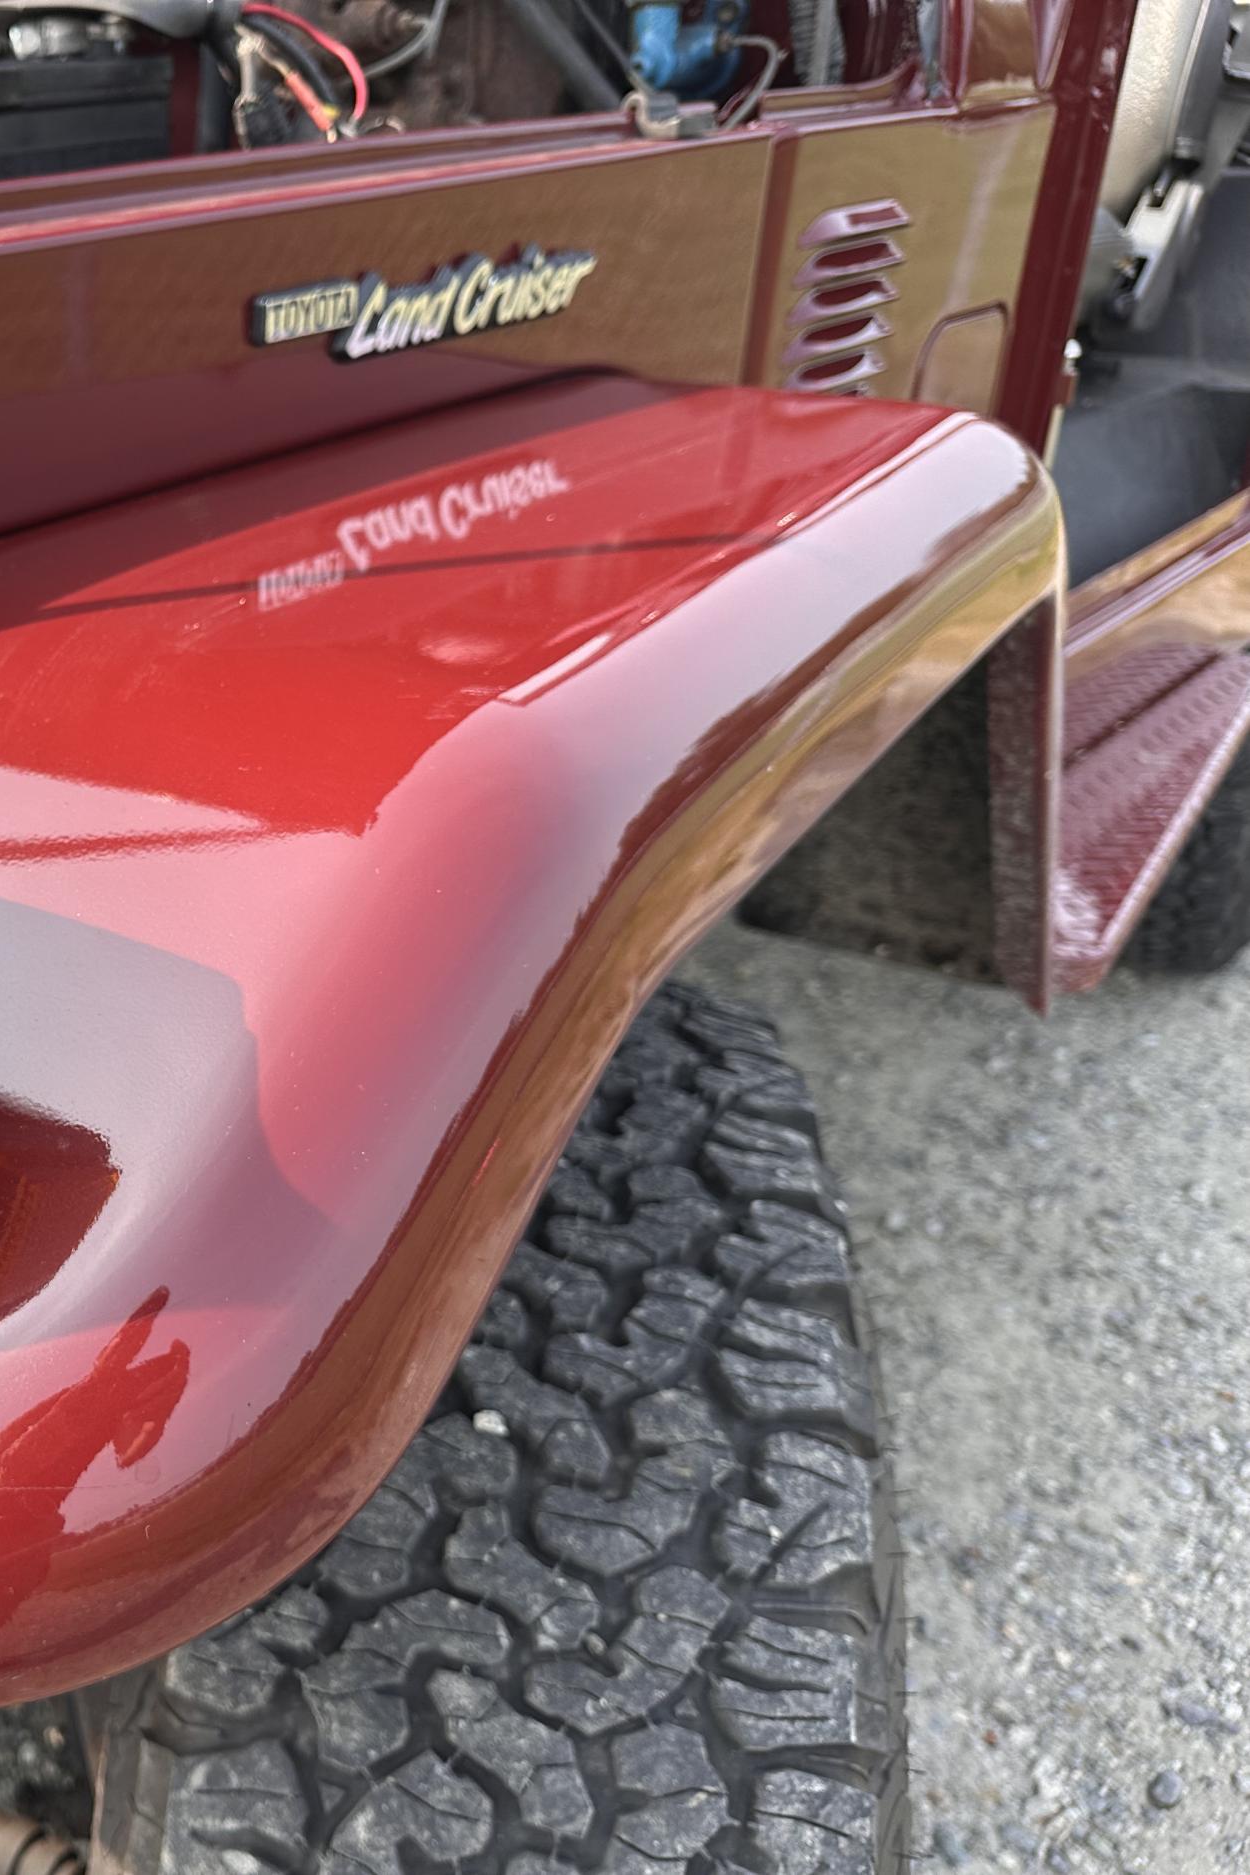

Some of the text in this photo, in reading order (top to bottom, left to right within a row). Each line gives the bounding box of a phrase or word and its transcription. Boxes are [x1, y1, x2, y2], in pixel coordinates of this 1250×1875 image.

[266, 253, 599, 360] TOYOTA Land Cruiser
